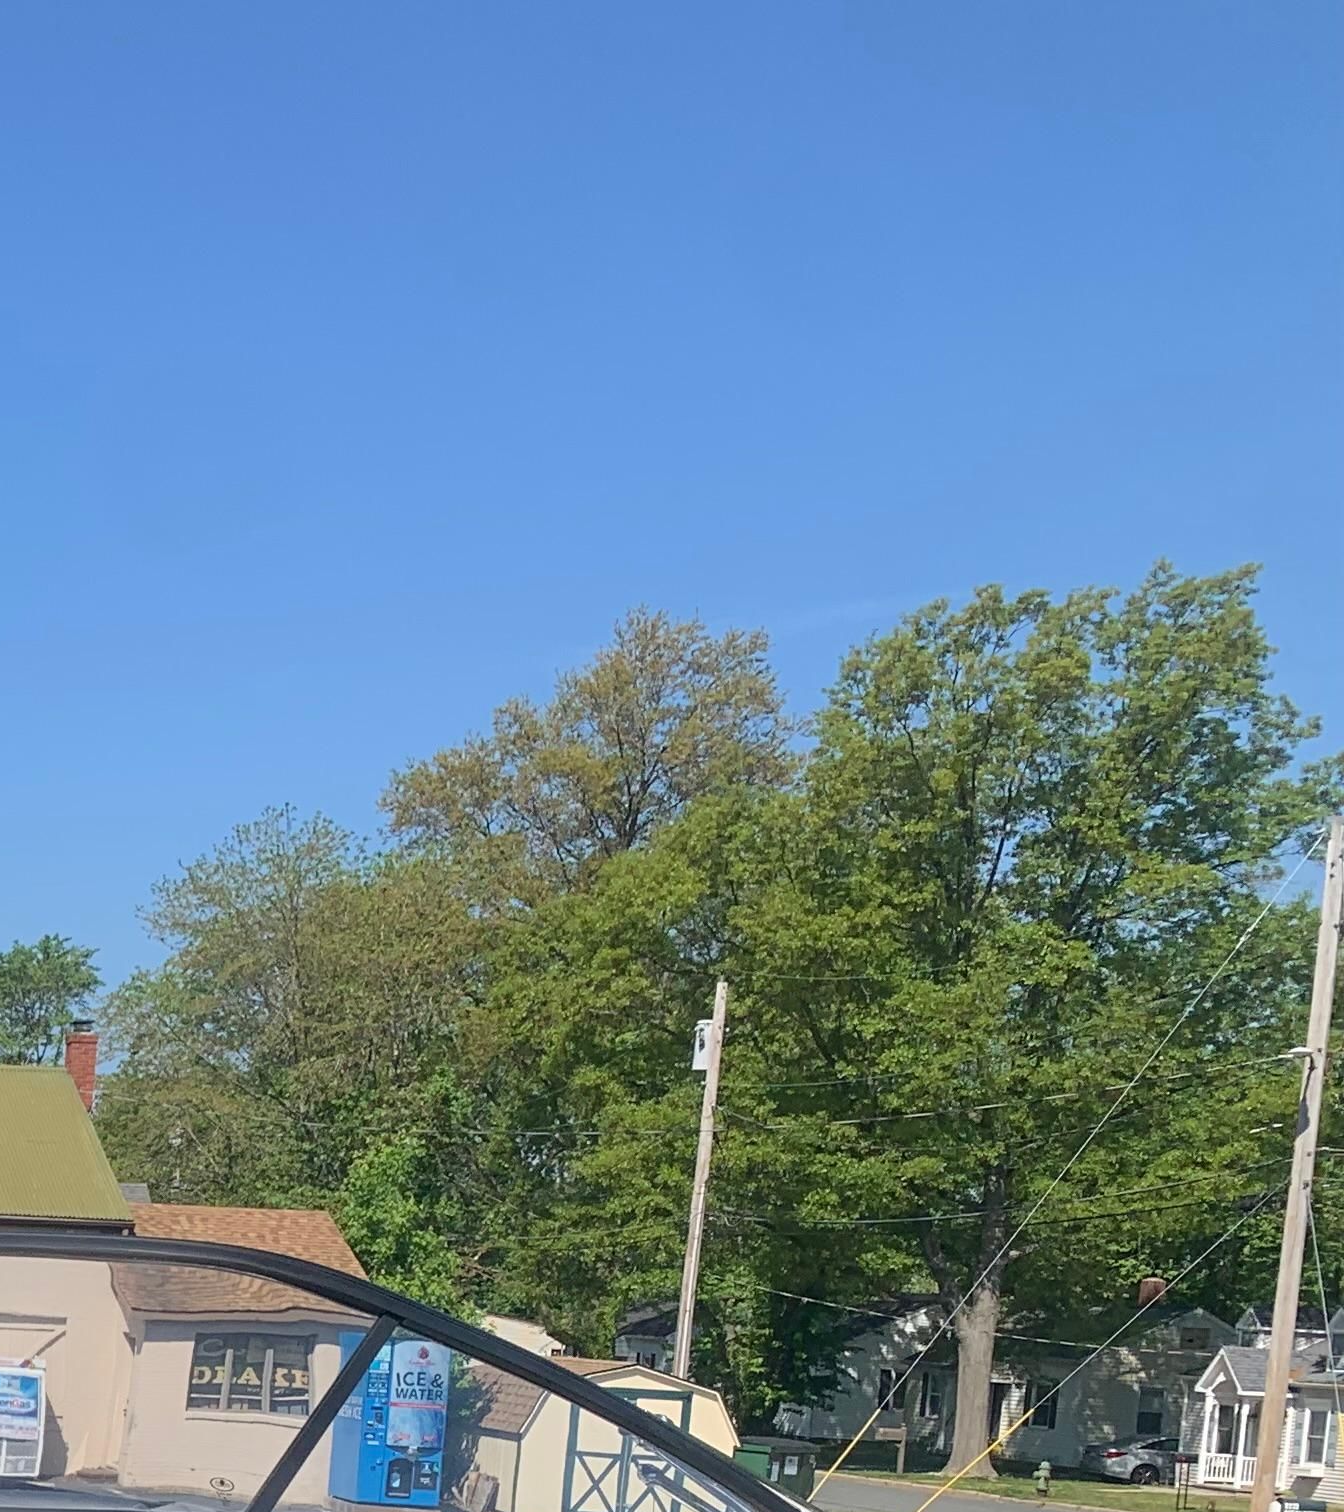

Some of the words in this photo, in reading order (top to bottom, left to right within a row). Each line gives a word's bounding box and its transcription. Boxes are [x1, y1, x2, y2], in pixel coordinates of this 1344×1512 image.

[396, 1371, 427, 1387] ICE
[430, 1373, 444, 1389] &
[395, 1387, 444, 1401] WATER
